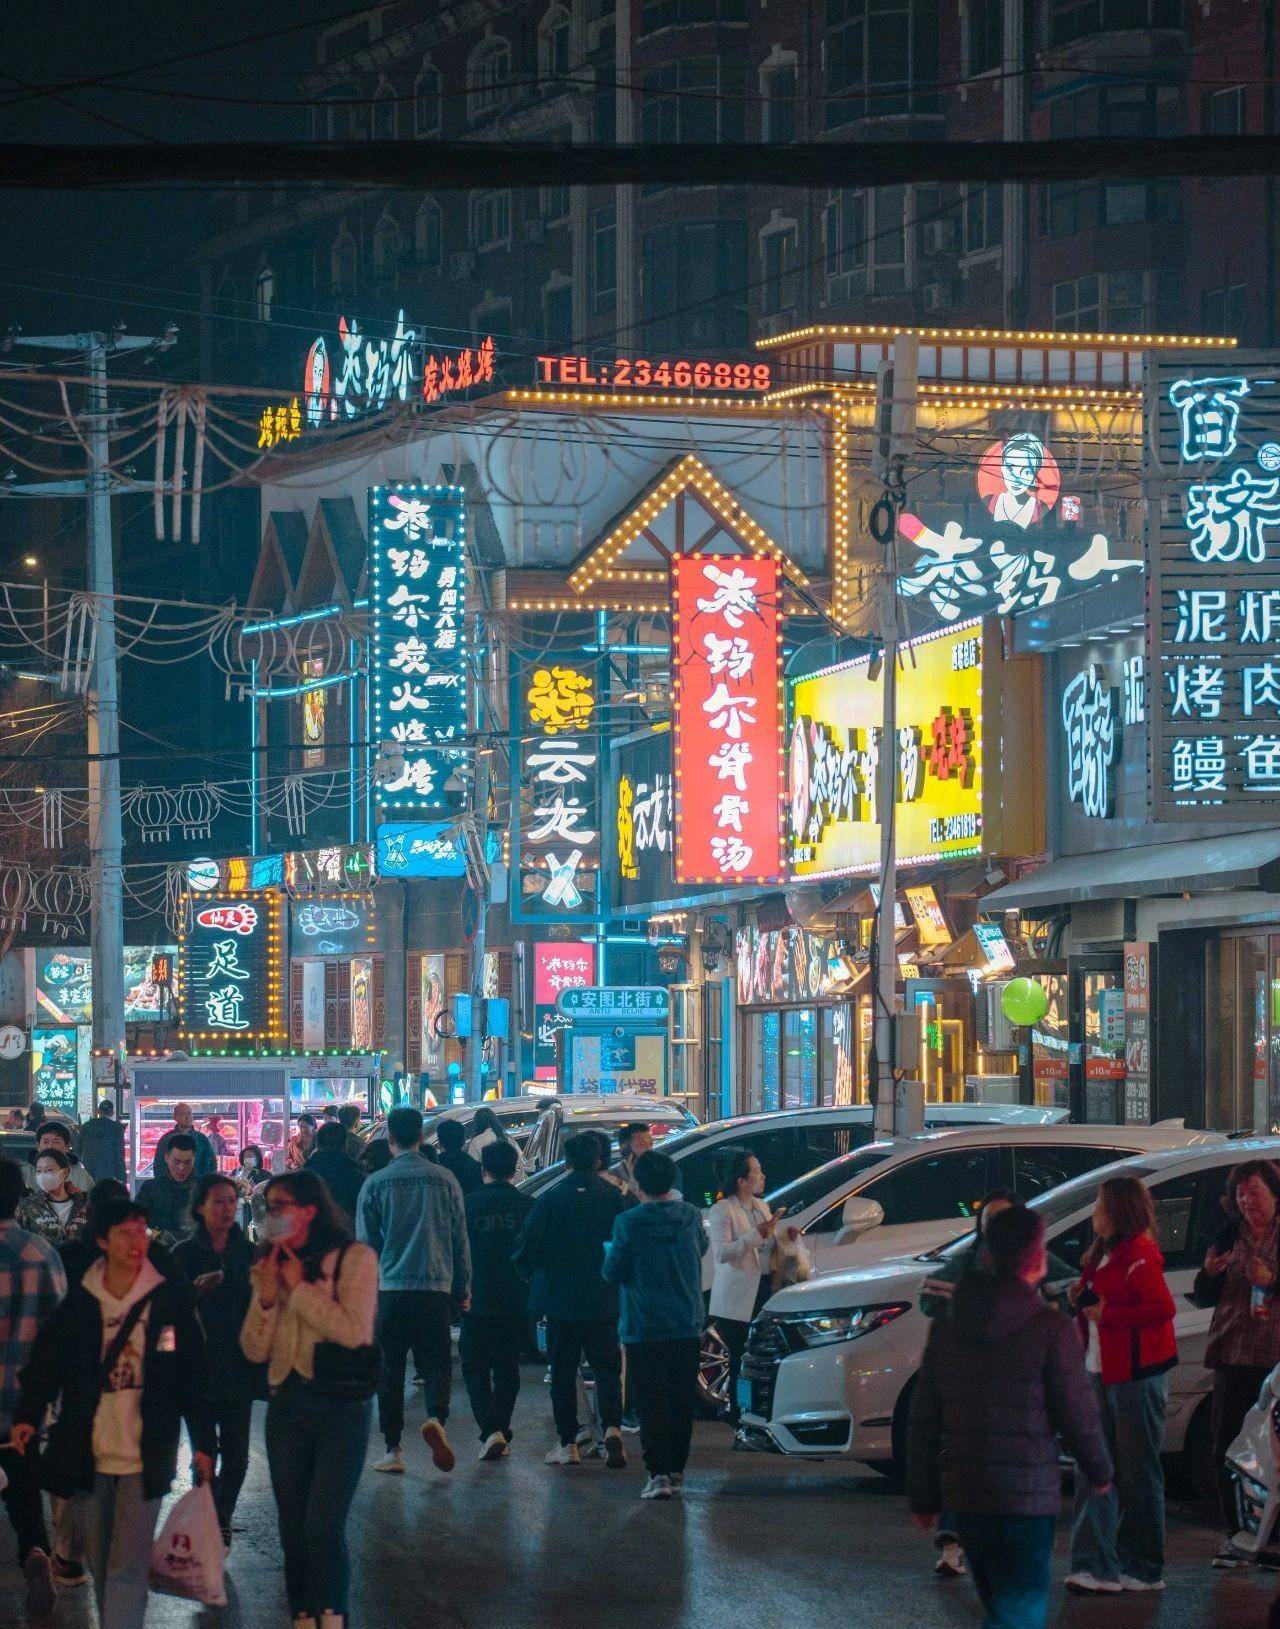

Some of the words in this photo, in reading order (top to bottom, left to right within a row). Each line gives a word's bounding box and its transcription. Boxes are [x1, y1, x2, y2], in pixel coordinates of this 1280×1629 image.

[537, 355, 771, 390] TEL:23466888
[1174, 589, 1280, 643] 泥炉
[1168, 662, 1280, 718] 烤肉
[1172, 736, 1280, 792] 鳗鱼
[526, 741, 596, 845] 云龙
[206, 939, 250, 1030] 足道
[581, 991, 652, 1008] 安图北街
[589, 1007, 611, 1015] ANTU
